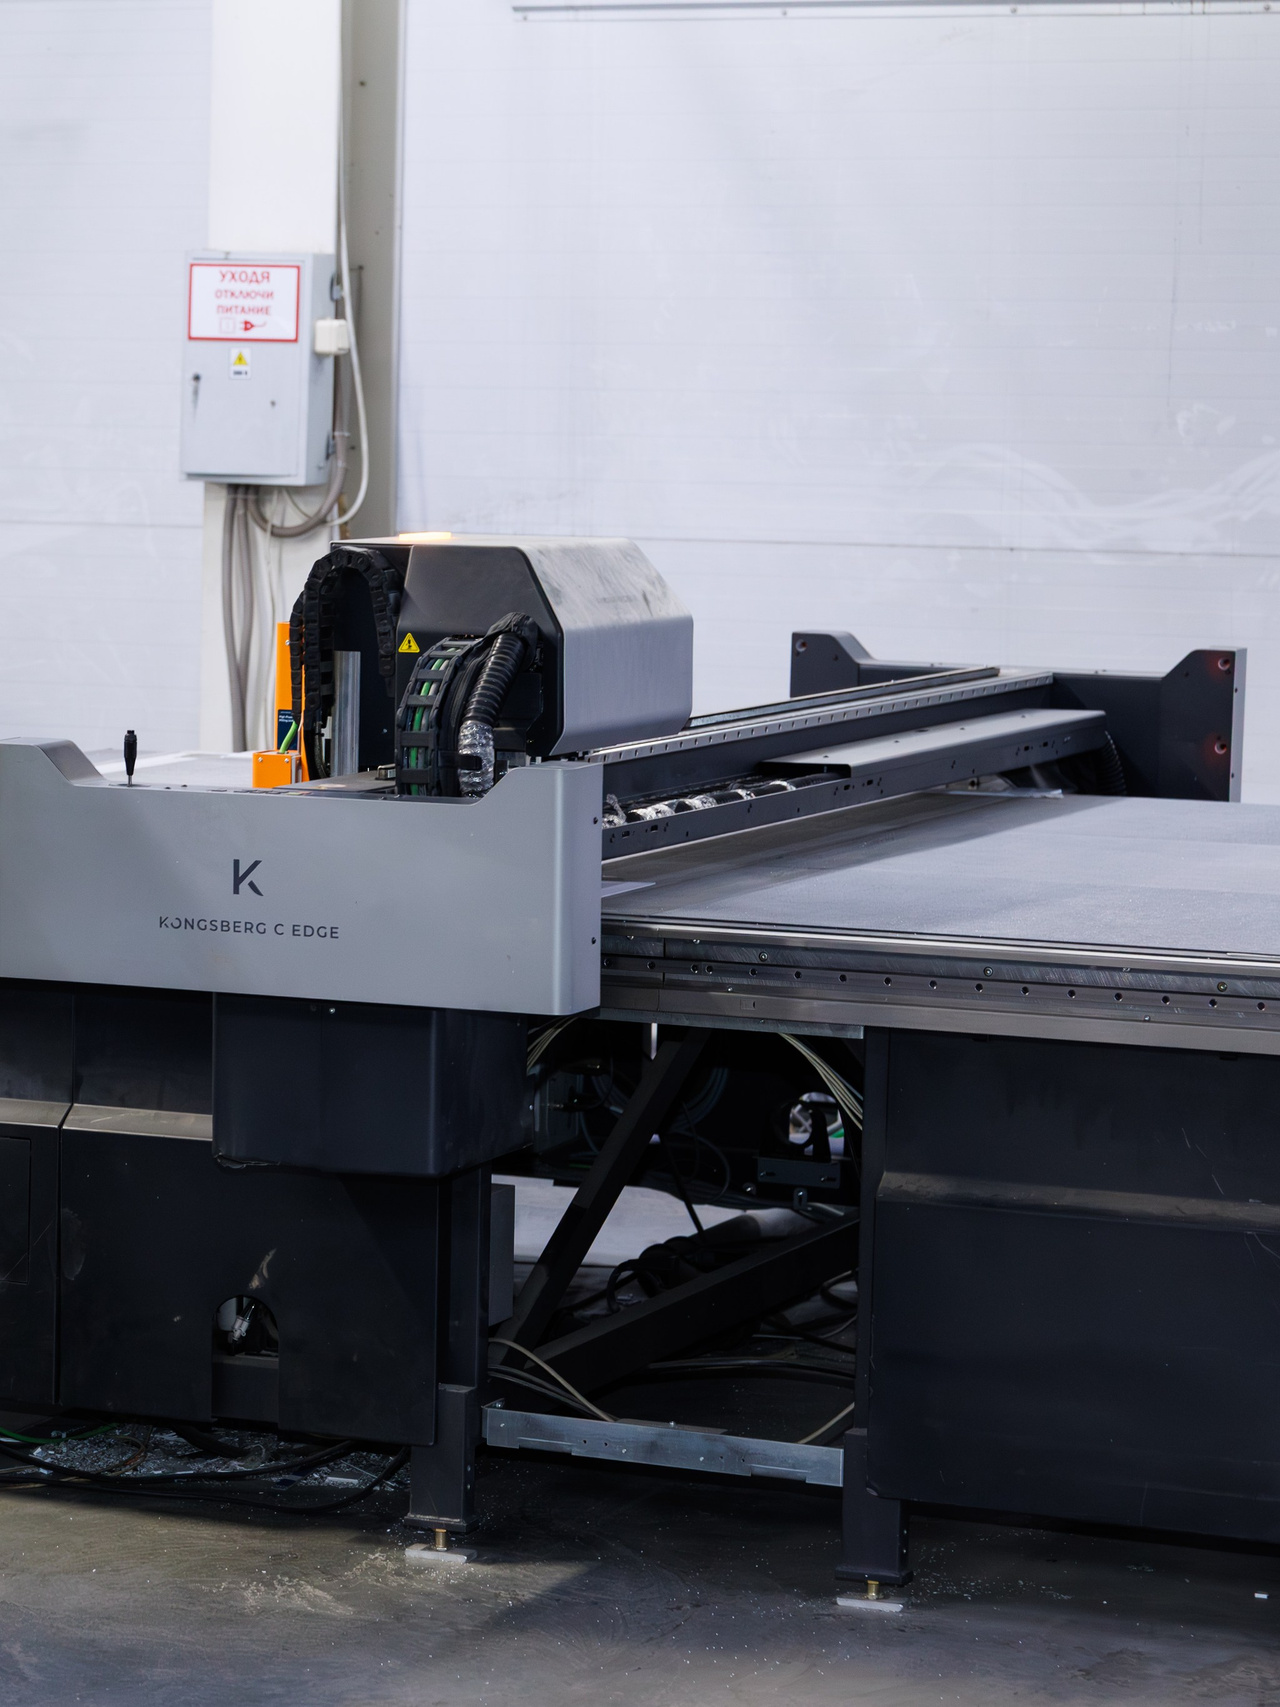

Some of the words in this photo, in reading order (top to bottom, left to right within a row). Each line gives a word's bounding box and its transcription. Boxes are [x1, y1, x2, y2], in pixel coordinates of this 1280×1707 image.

[219, 270, 271, 284] УХОДЯ
[214, 289, 274, 300] ОТКЛЮЧИ
[216, 305, 271, 315] ПИТАНИЕ
[232, 858, 264, 897] K
[158, 915, 267, 935] KONGSBERG
[273, 922, 285, 936] C
[291, 924, 340, 939] EDGE
